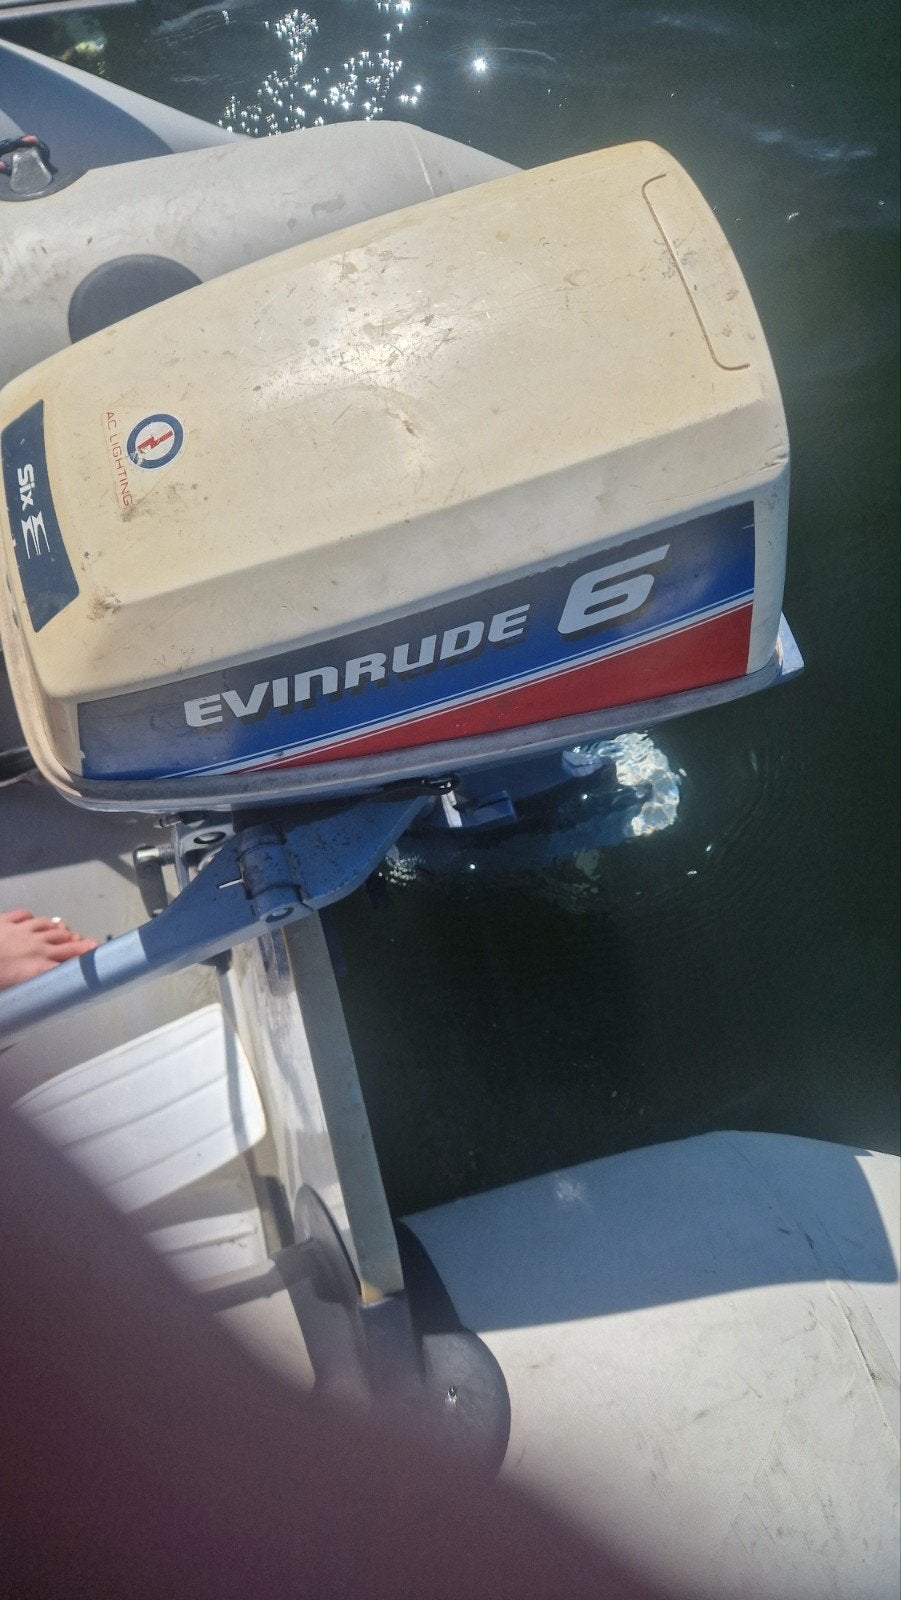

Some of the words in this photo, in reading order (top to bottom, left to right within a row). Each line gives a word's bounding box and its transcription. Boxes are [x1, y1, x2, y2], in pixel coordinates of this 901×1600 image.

[106, 411, 118, 430] AC
[109, 433, 133, 506] LIGHTING
[184, 604, 530, 727] EVINRUDE
[557, 544, 670, 634] 6
